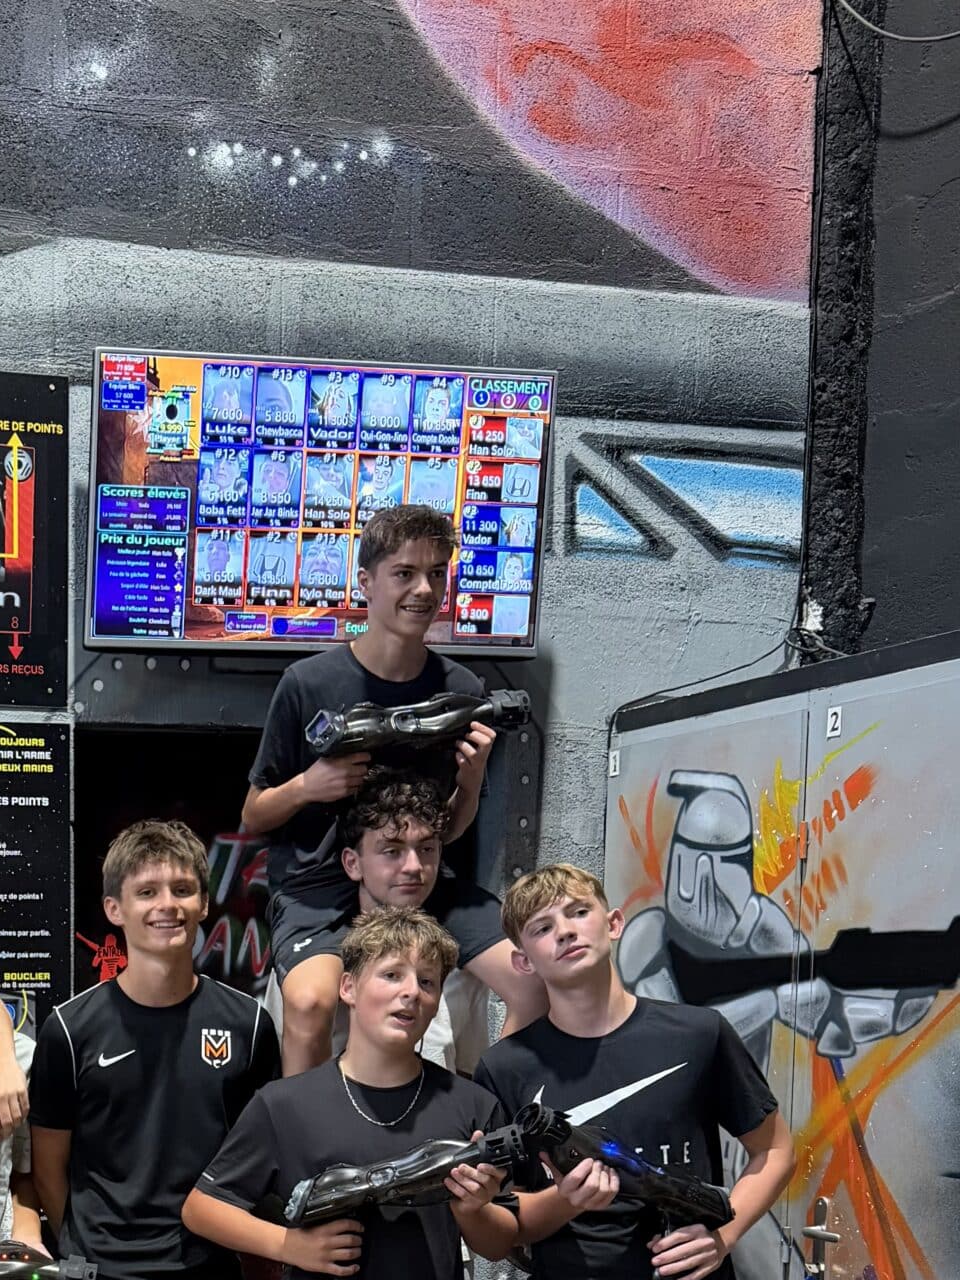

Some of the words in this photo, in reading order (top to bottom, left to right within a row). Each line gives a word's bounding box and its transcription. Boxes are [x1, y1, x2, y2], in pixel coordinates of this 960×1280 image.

[471, 380, 548, 394] CLASSEMENT
[11, 421, 25, 432] DE
[26, 422, 63, 434] POINTS
[205, 423, 248, 434] Luke
[310, 428, 355, 439] Vador
[469, 444, 489, 455] Han
[102, 487, 144, 497] Scores
[147, 487, 186, 499] élevés
[466, 489, 488, 500] Finn
[199, 505, 224, 515] Boba
[226, 506, 246, 515] Fett
[251, 507, 263, 517] Jar
[265, 507, 276, 517] Jar
[304, 509, 325, 519] Han
[328, 509, 350, 520] Solo
[465, 521, 475, 531] 11
[479, 521, 497, 532] 300
[101, 534, 123, 544] Prix
[126, 534, 142, 545] du
[143, 534, 184, 547] joueur
[462, 534, 492, 545] Vador
[195, 585, 217, 596] Dark
[218, 586, 242, 596] Maul
[250, 587, 292, 598] Finn
[300, 588, 322, 600] Kylo
[325, 589, 345, 599] Ren
[11, 616, 19, 629] 8
[11, 664, 44, 676] REÇUS
[830, 711, 839, 733] 2
[15, 750, 52, 760] L'ARME
[22, 763, 53, 773] MAINS
[612, 754, 619, 772] 1
[11, 796, 49, 806] POINTS
[3, 972, 51, 981] BOUCLIER
